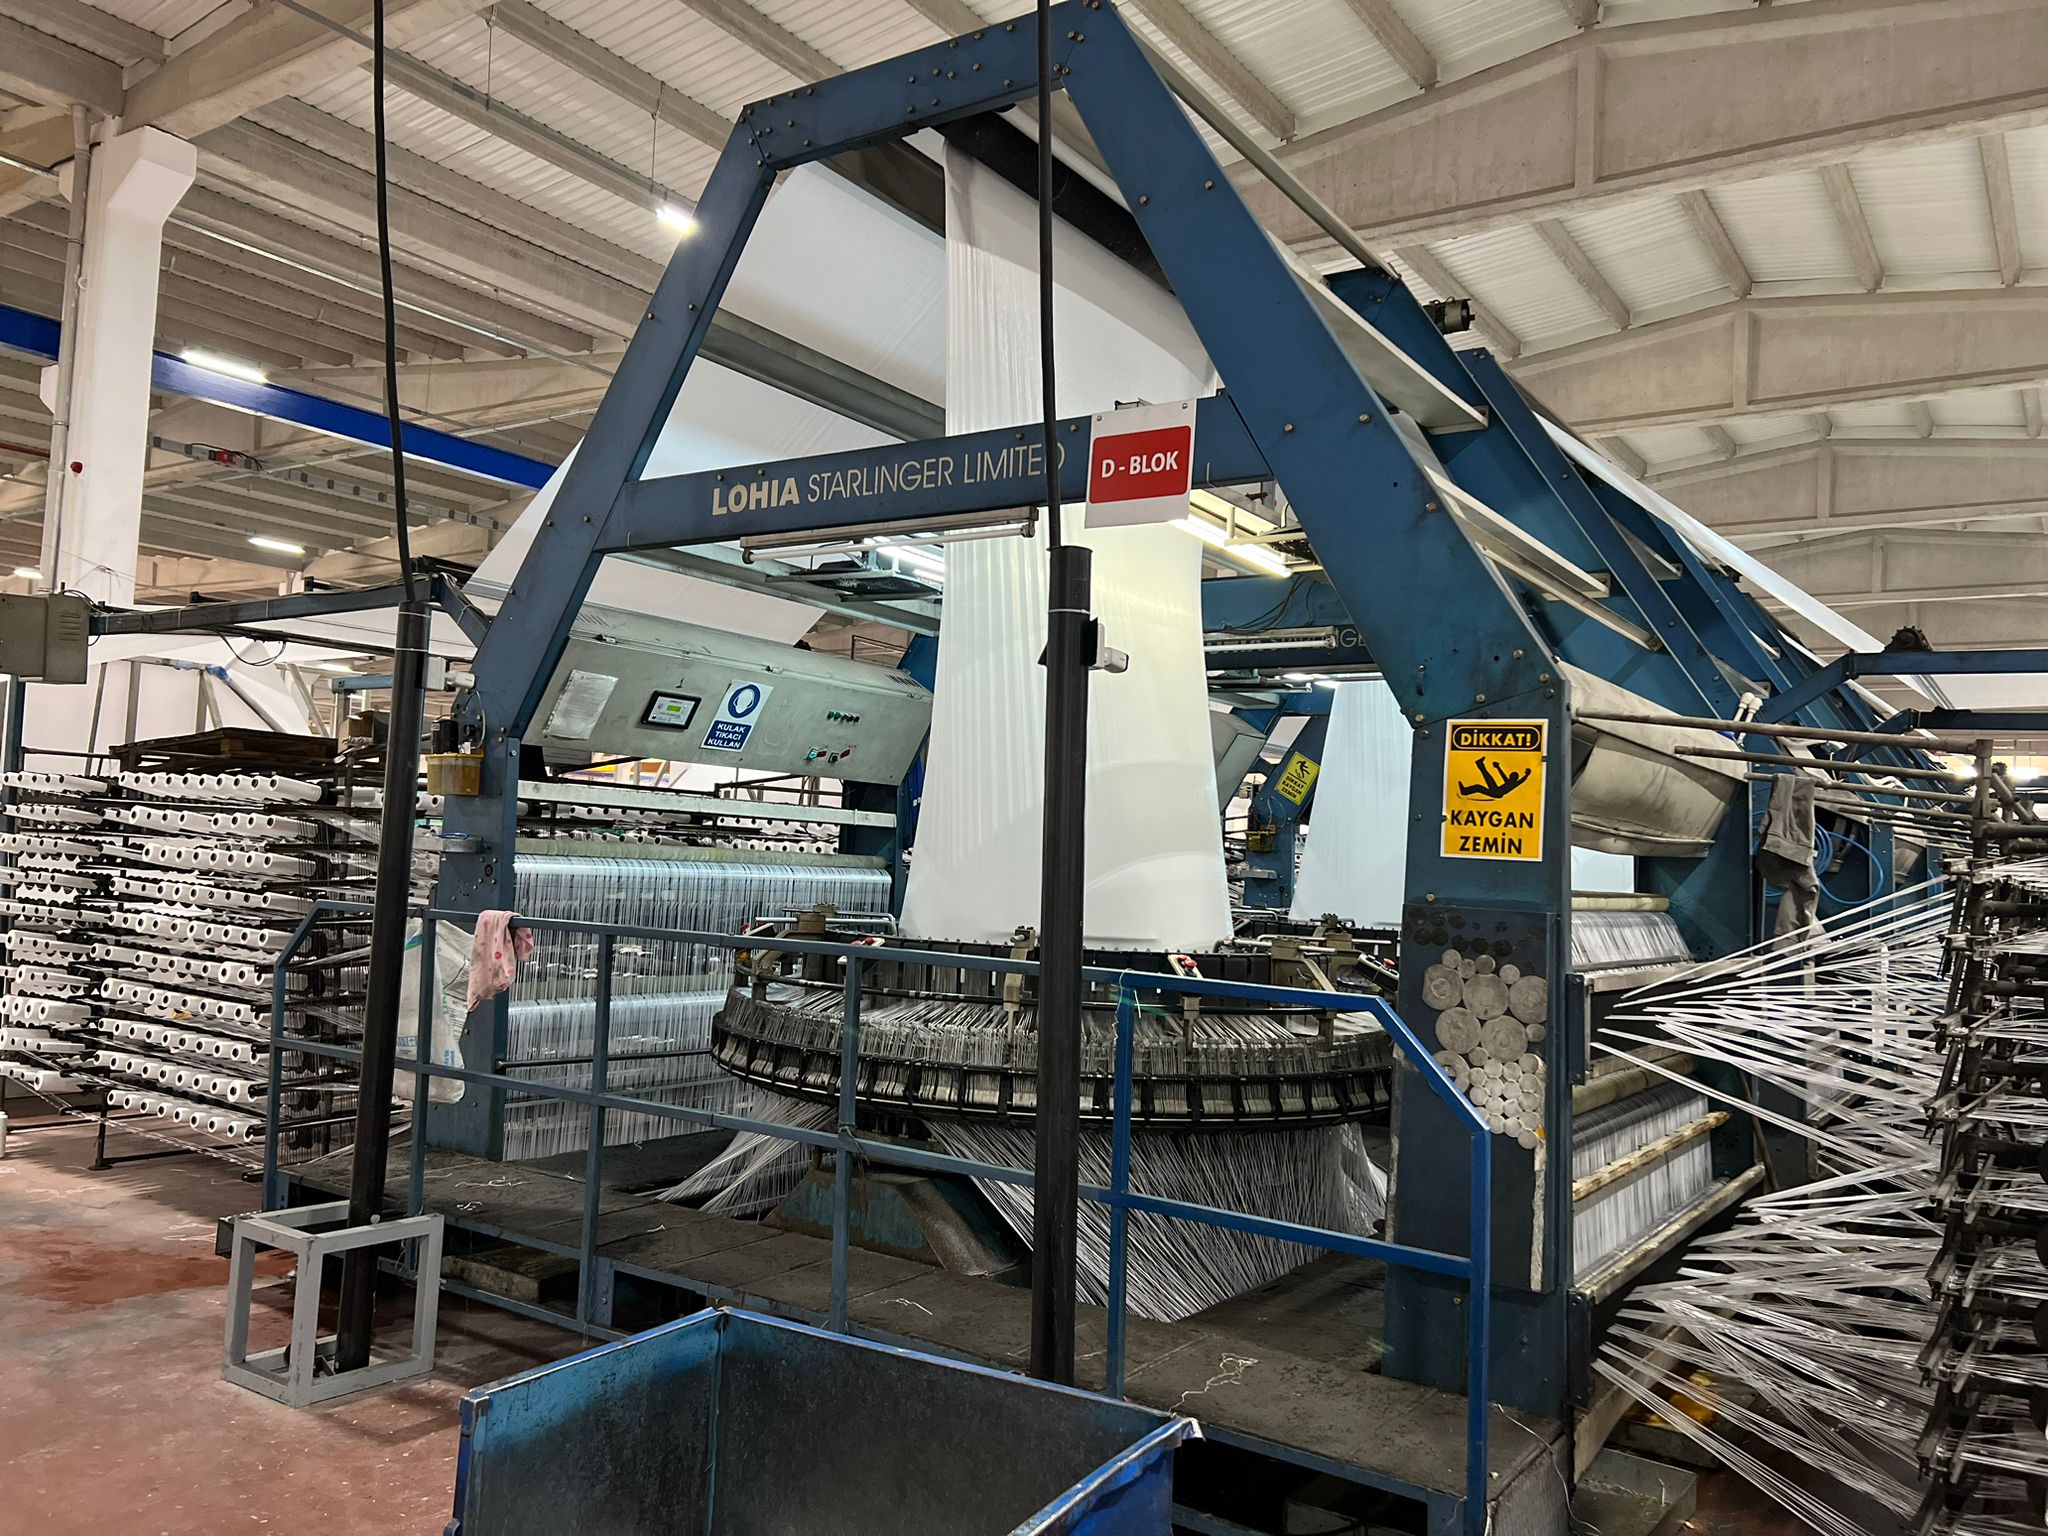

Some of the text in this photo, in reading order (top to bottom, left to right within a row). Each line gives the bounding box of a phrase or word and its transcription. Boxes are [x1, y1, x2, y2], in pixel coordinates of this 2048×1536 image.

[712, 477, 800, 516] LOHIA
[807, 456, 954, 503] STARLINGER
[717, 723, 746, 733] KULAK
[707, 738, 741, 748] KULLAN
[1460, 729, 1532, 747] DİKKAT!
[1282, 780, 1302, 795] KAYGAN
[1450, 810, 1534, 829] KAYGAN
[1459, 832, 1522, 854] ZEMİN
